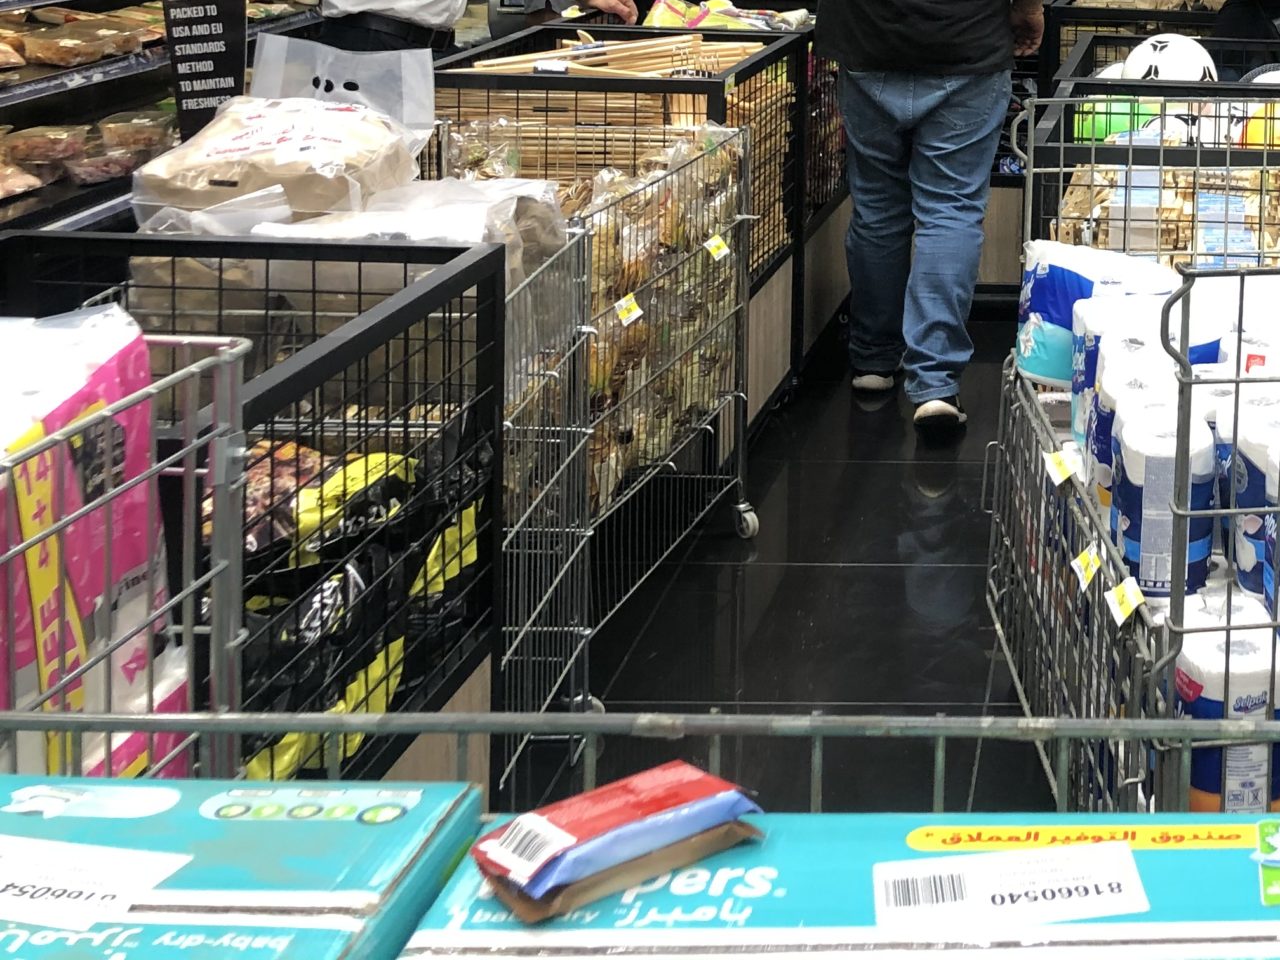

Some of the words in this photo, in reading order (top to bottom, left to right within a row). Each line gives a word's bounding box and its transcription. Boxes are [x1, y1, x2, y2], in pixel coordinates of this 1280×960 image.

[170, 6, 205, 19] PACKED
[205, 5, 217, 16] TO
[172, 25, 191, 37] USA
[192, 24, 210, 35] AND
[211, 23, 223, 34] EU
[175, 41, 226, 56] STANDARDS
[177, 60, 214, 74] METHOD
[180, 80, 192, 92] TO
[192, 77, 235, 91] MAINTAIN
[1234, 690, 1268, 711] Selpak
[941, 829, 1040, 847] العملاق
[1150, 830, 1242, 846] صندوق
[620, 866, 787, 905] pers.
[991, 881, 1123, 907] 81660540
[154, 929, 295, 954] baby-dry
